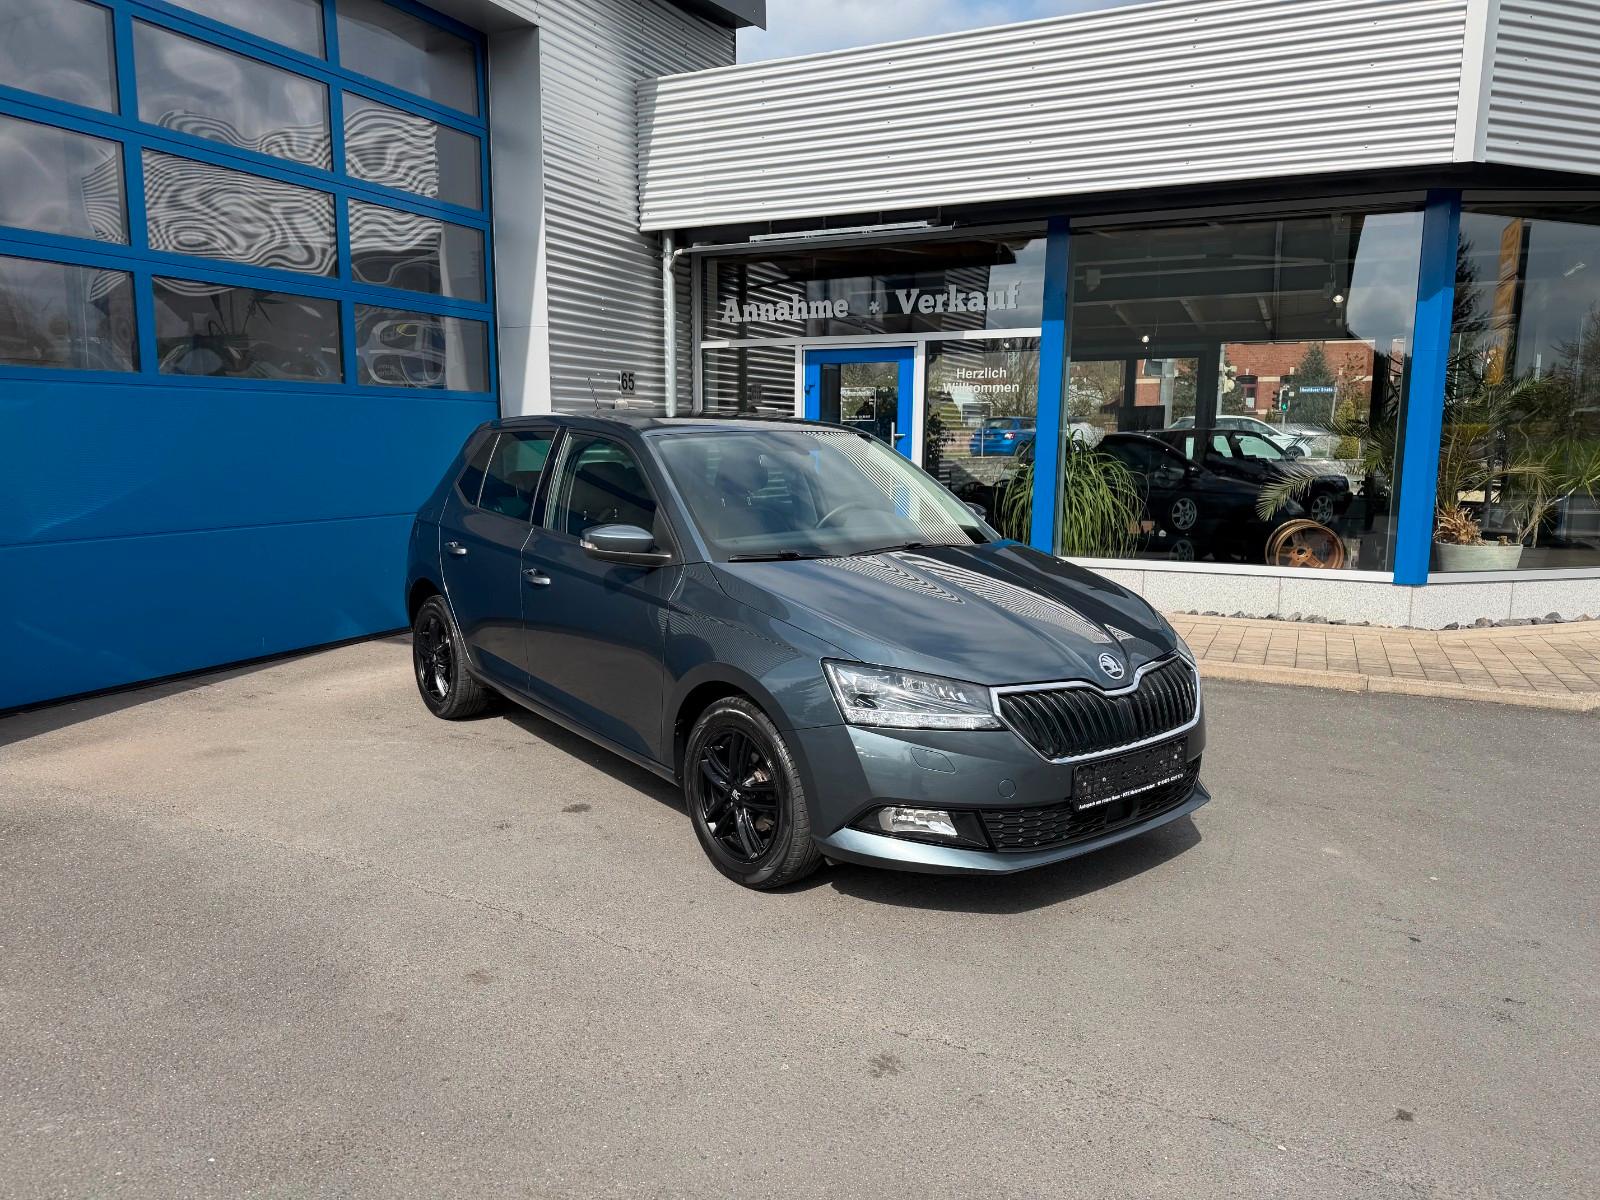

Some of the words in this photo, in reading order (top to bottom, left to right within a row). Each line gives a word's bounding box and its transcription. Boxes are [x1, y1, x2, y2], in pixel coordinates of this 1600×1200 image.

[721, 293, 849, 323] Annahme
[895, 280, 1022, 315] Verkauf
[956, 367, 1007, 379] Herzlich
[621, 372, 635, 391] 65
[943, 382, 1020, 394] Willkommen
